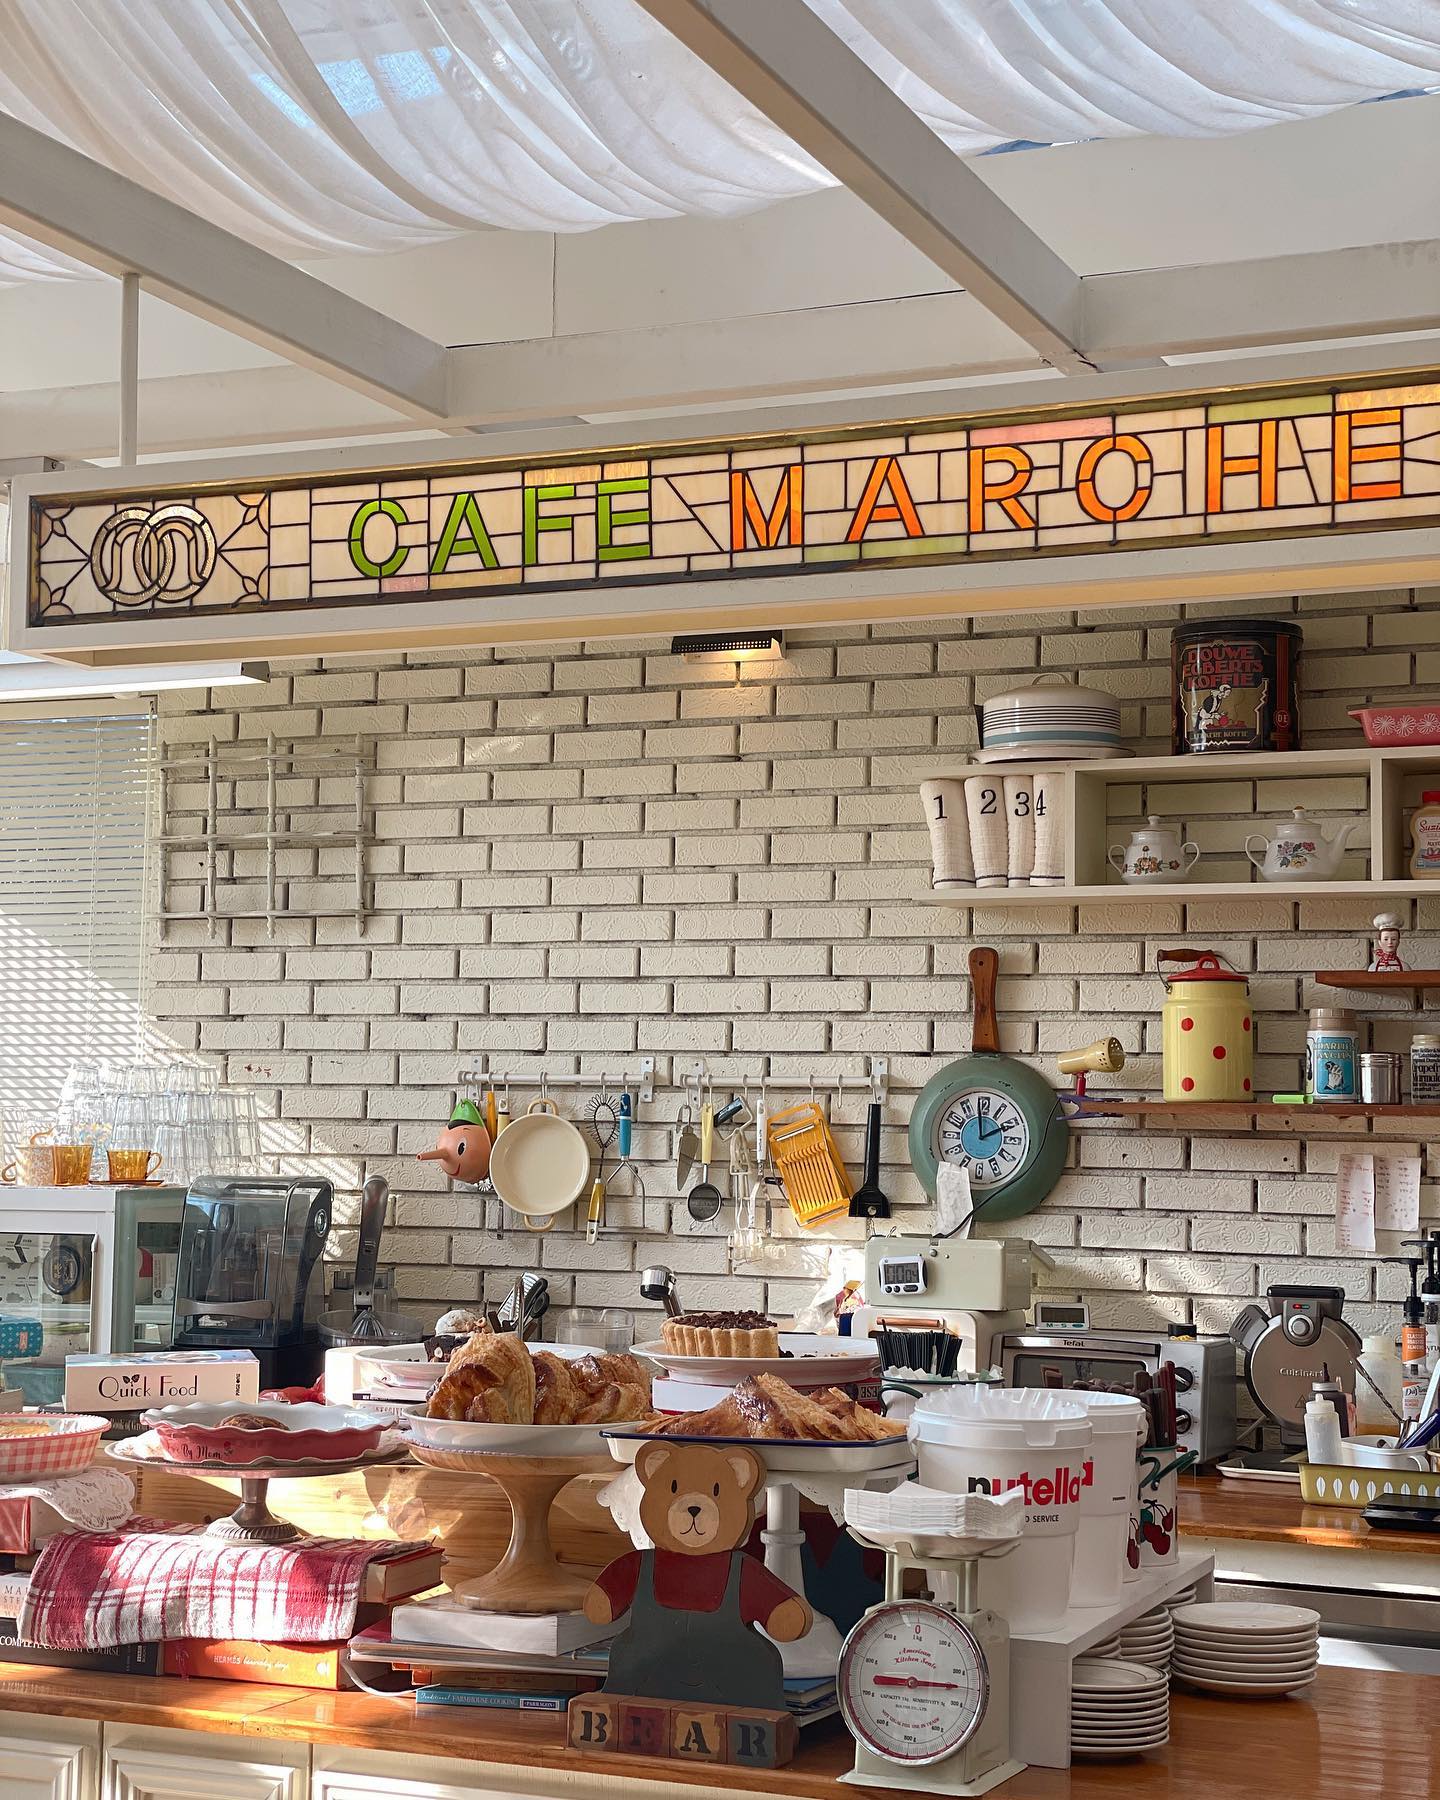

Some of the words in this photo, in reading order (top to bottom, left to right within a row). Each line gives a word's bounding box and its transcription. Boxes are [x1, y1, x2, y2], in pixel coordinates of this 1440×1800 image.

[348, 479, 651, 578] CAFE
[730, 409, 1401, 551] MARCHE
[1187, 645, 1255, 663] DOUWE
[1183, 660, 1263, 676] EGBERTS
[1187, 673, 1255, 689] KOFFIE
[933, 794, 948, 820] 1
[980, 789, 997, 815] 2
[1014, 791, 1030, 817] 3
[1035, 789, 1047, 816] 4
[961, 1100, 974, 1117] 11
[948, 1112, 964, 1127] 10
[1005, 1136, 1020, 1145] 3
[947, 1146, 961, 1155] 8
[1000, 1149, 1015, 1162] 4
[976, 1163, 983, 1177] 6
[990, 1160, 1001, 1175] 5
[1280, 1367, 1324, 1378] Cuisinart
[99, 1374, 151, 1401] Quick
[160, 1375, 198, 1397] Food
[1032, 1514, 1059, 1523] SERVICE
[914, 1624, 921, 1635] 0
[895, 1655, 919, 1664] Kitchen
[899, 1647, 931, 1657] American
[452, 1695, 489, 1704] FARMHOUSE
[490, 1697, 518, 1706] COOKING
[579, 1710, 770, 1758] BEAR
